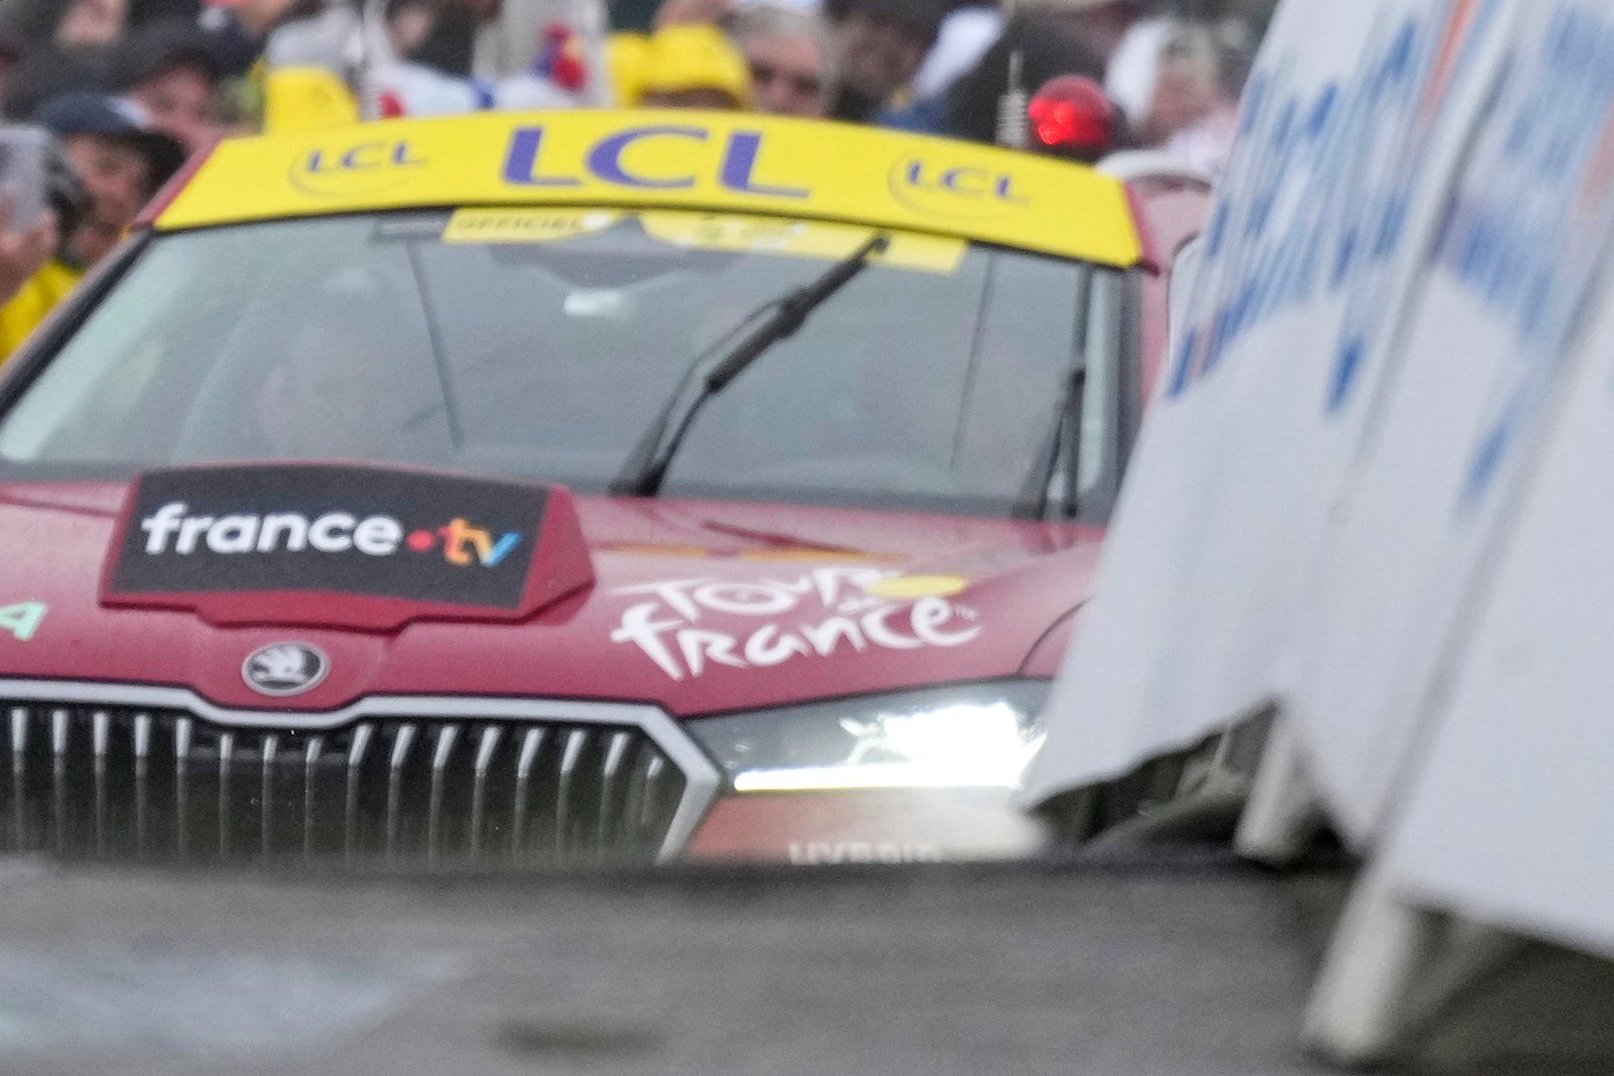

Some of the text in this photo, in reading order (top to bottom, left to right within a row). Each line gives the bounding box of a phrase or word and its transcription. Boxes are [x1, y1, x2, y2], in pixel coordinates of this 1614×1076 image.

[307, 139, 428, 174] LCL
[499, 123, 811, 200] LCL
[907, 159, 1032, 208] LCL
